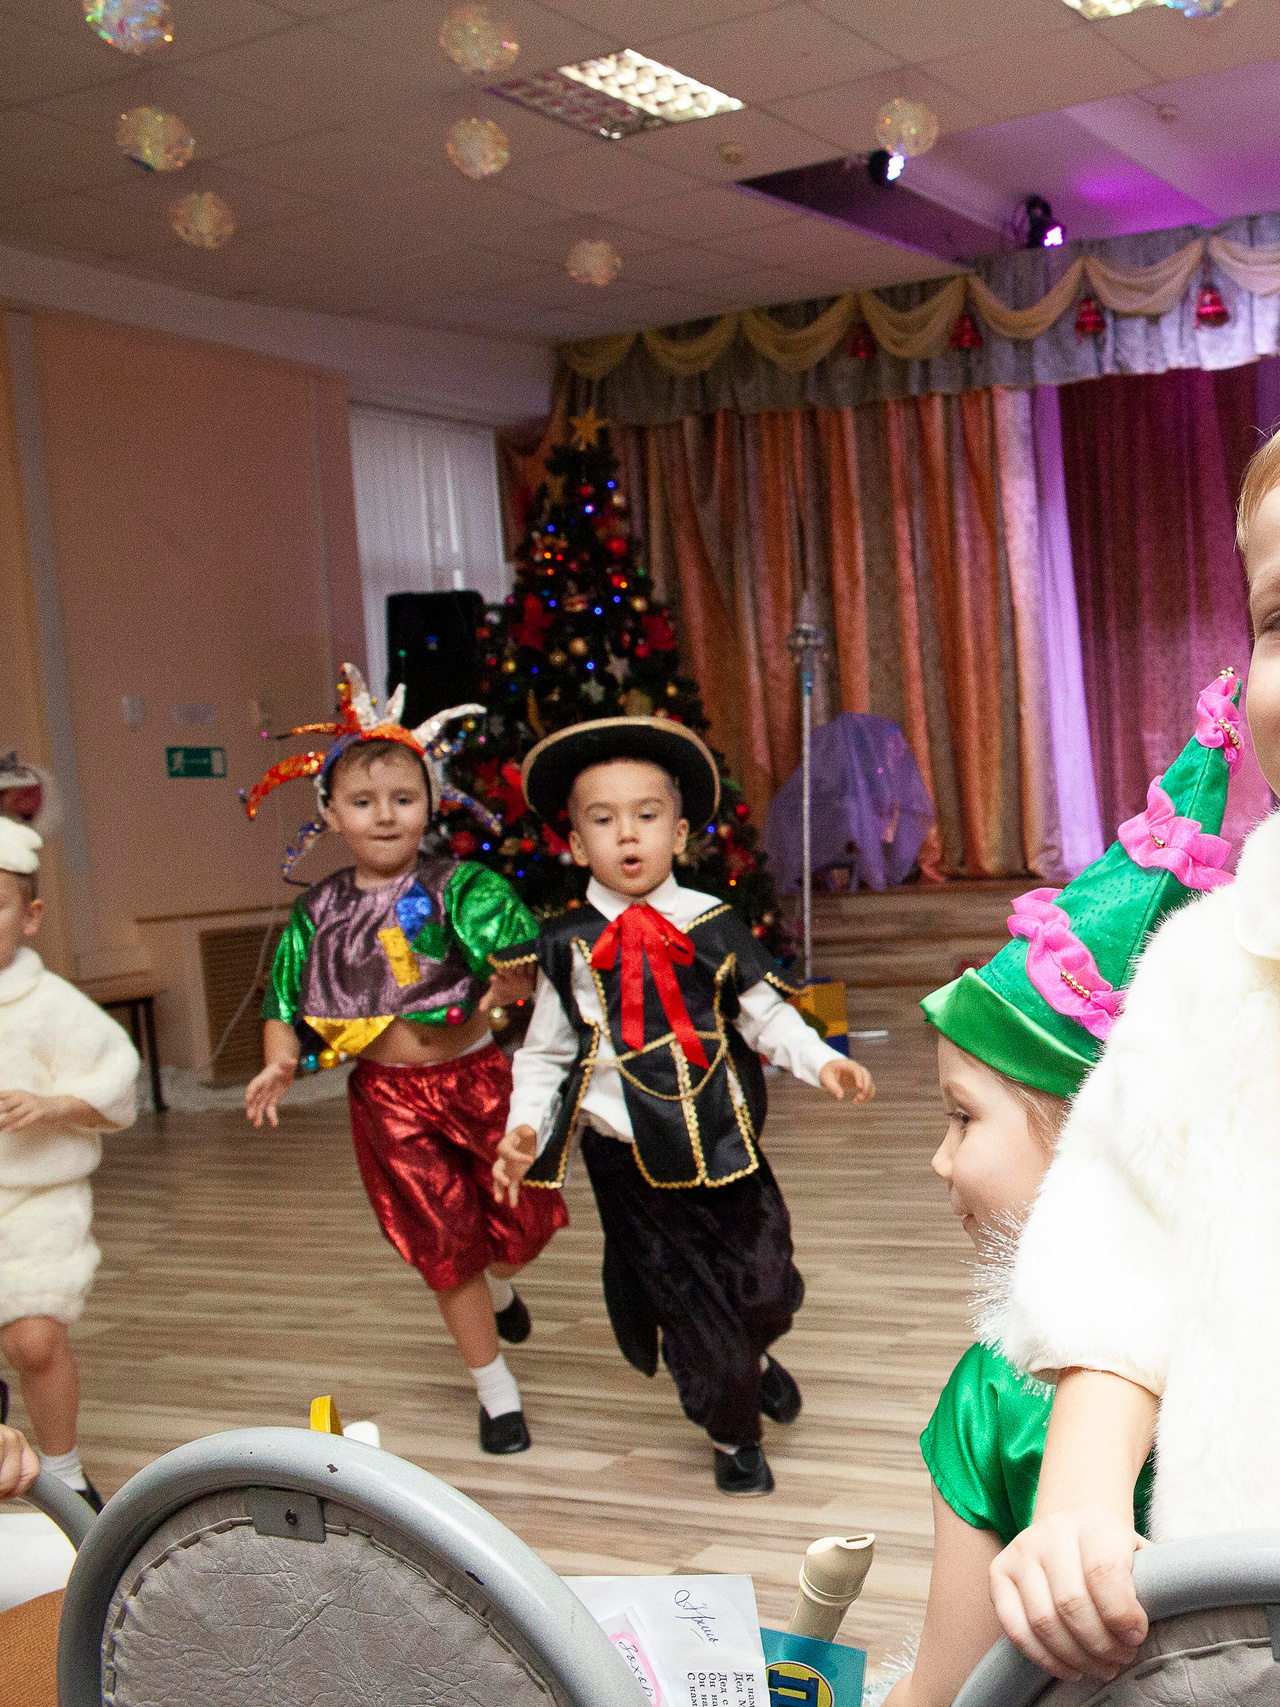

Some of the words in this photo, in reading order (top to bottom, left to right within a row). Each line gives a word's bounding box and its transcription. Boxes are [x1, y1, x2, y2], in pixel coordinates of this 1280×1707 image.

[687, 1672, 695, 1680] С
[698, 1672, 706, 1687] Он
[709, 1672, 716, 1687] Он
[717, 1672, 727, 1693] Дед
[733, 1672, 743, 1692] Дед
[746, 1673, 754, 1681] К
